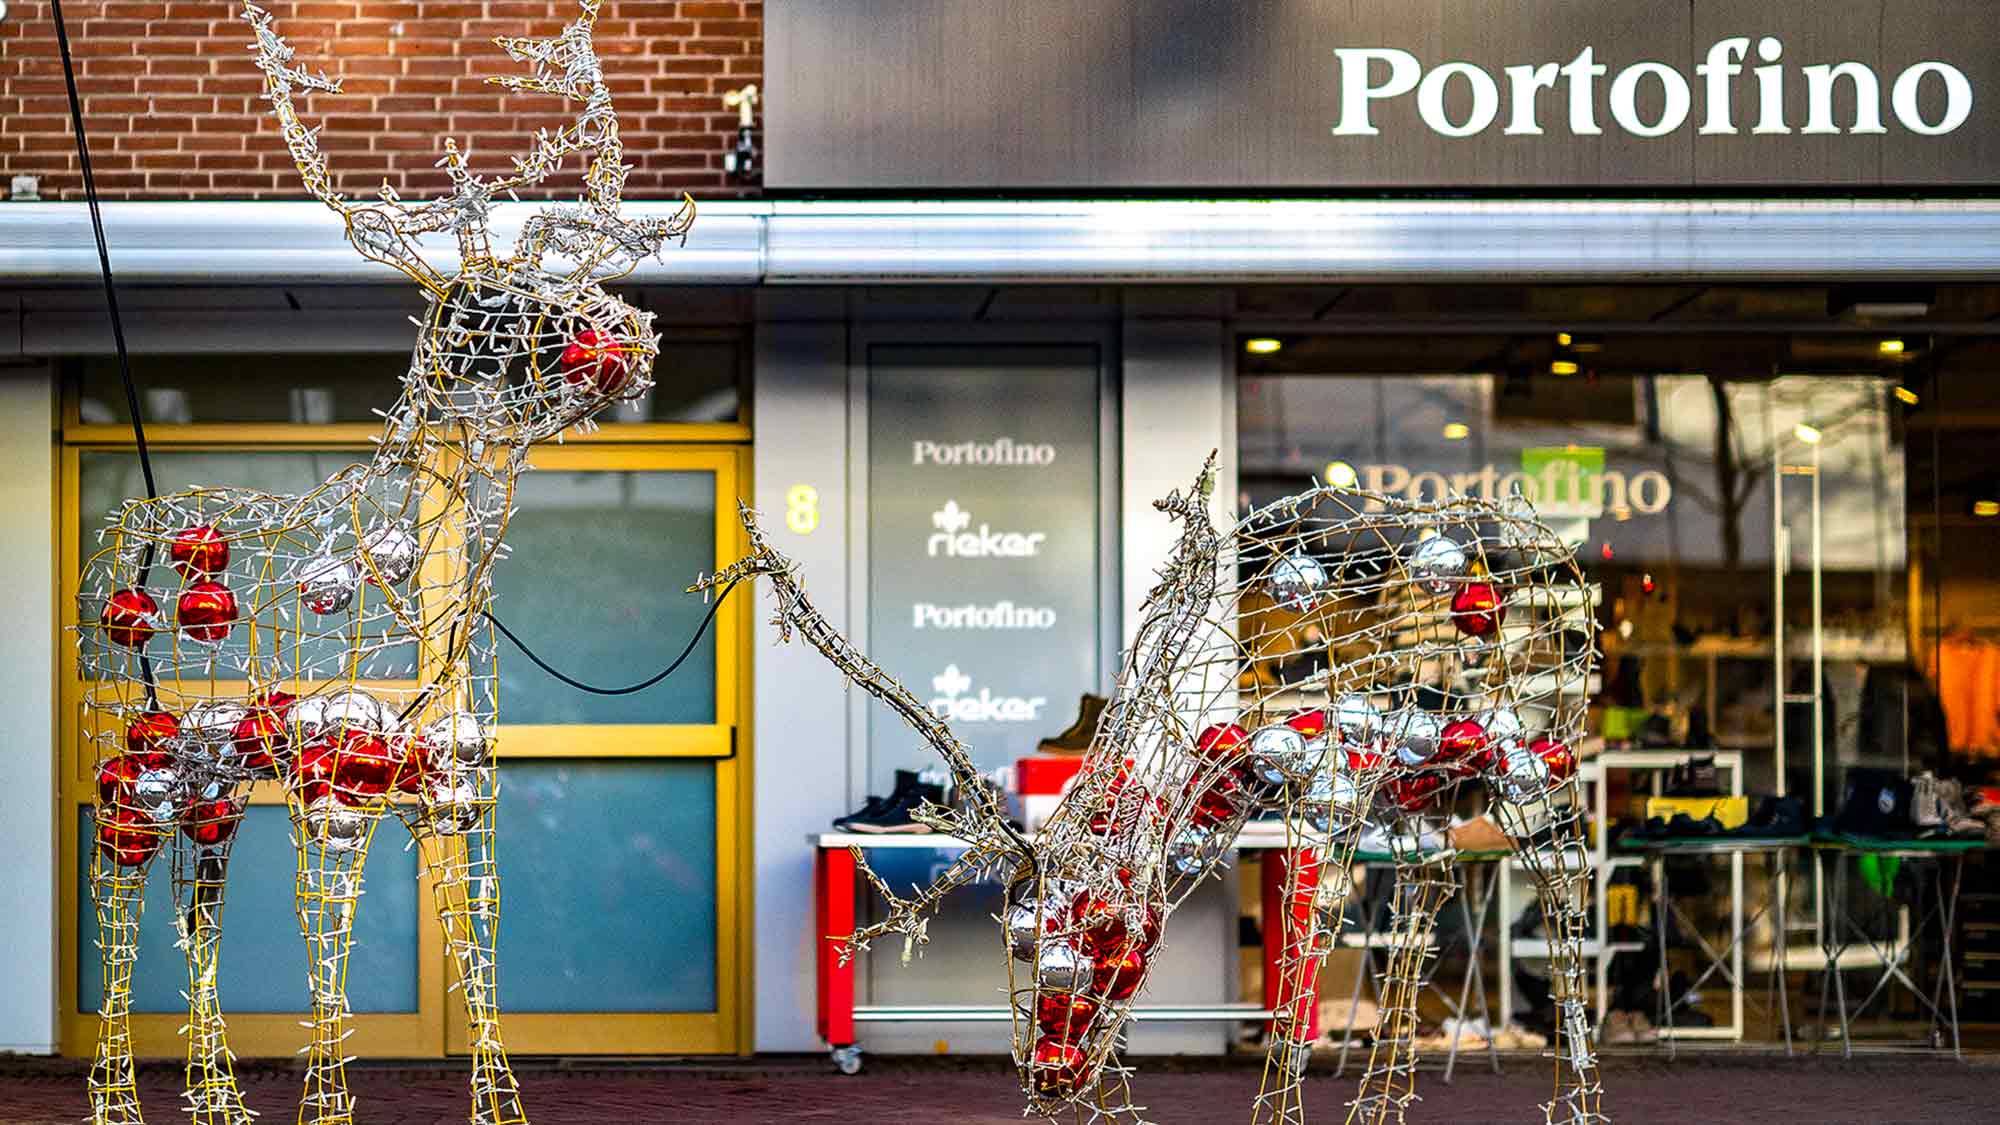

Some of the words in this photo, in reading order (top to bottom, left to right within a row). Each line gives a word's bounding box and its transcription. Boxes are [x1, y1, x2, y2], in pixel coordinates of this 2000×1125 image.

[1331, 36, 1973, 138] Portofino
[912, 438, 1056, 466] Portofino
[1363, 459, 1672, 515] Portofino
[785, 483, 819, 535] 8
[927, 523, 1046, 557] rieker
[912, 601, 1057, 630] Portofino
[928, 687, 1047, 722] rieker
